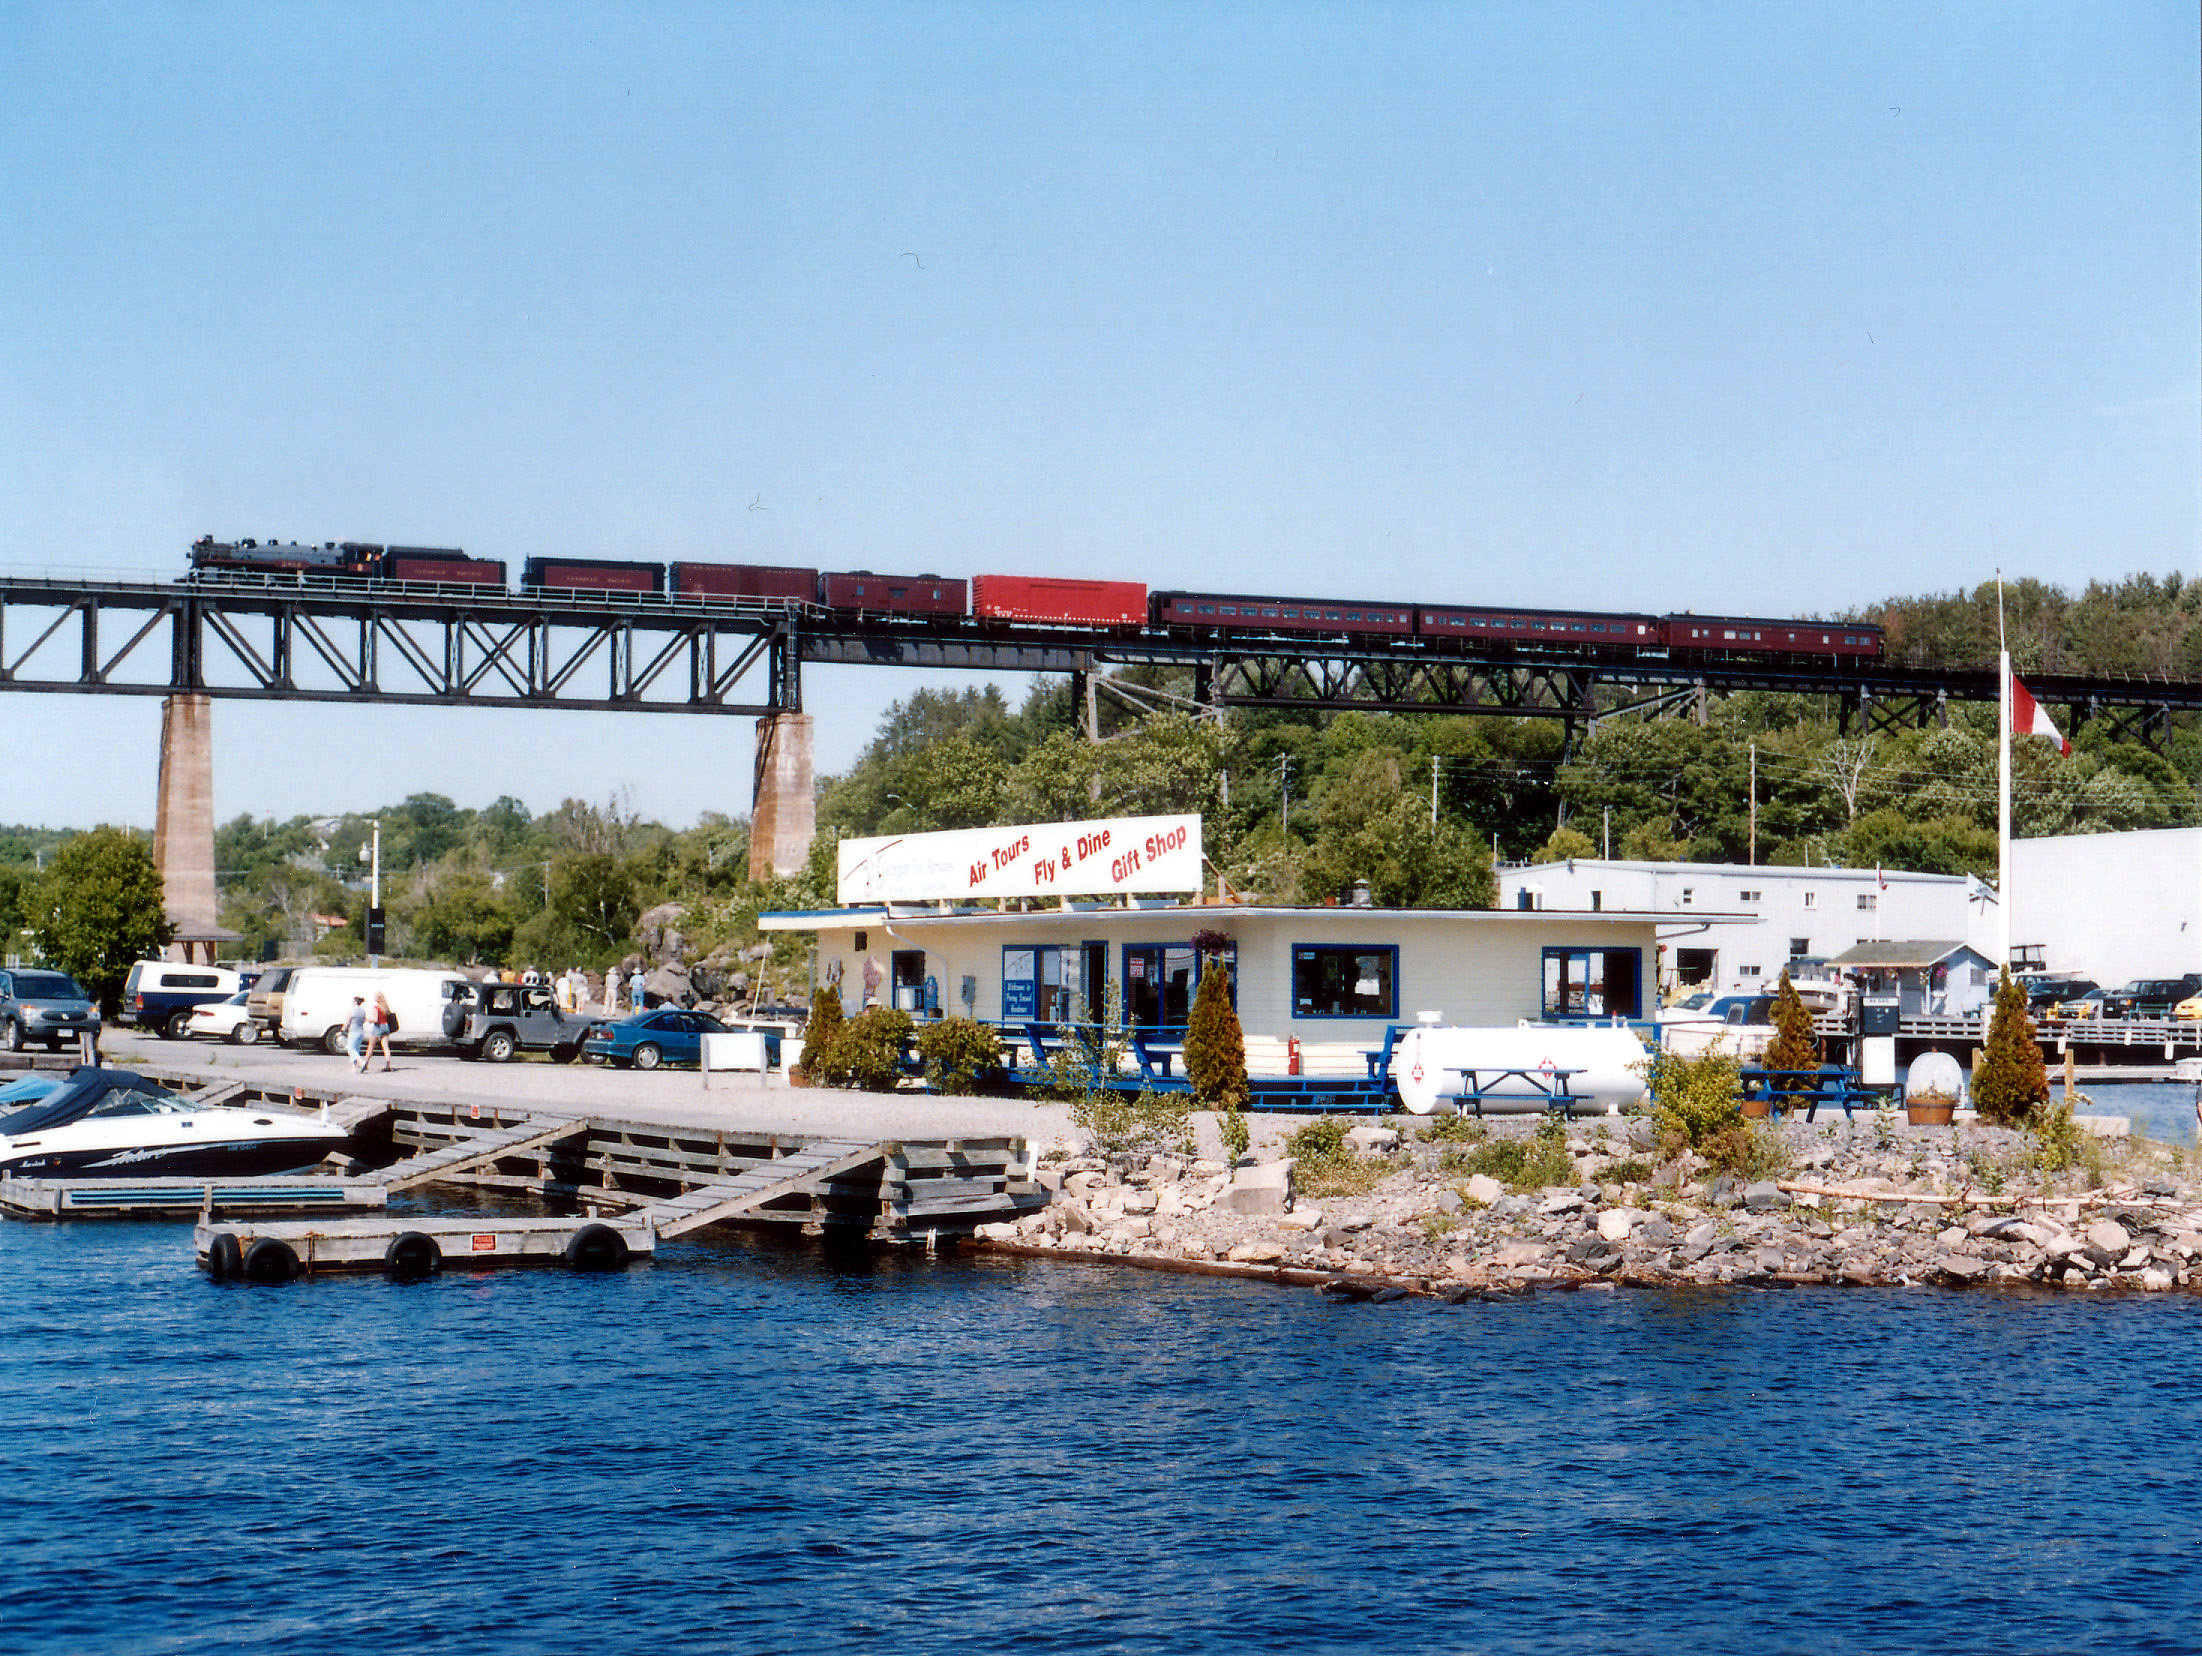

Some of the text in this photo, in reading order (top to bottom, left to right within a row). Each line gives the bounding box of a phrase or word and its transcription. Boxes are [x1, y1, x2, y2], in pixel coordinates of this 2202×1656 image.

[970, 860, 987, 888] Air
[991, 835, 1030, 871] Tours
[1034, 829, 1111, 885] Fly & Dine
[1112, 825, 1186, 883] Gift Shop
